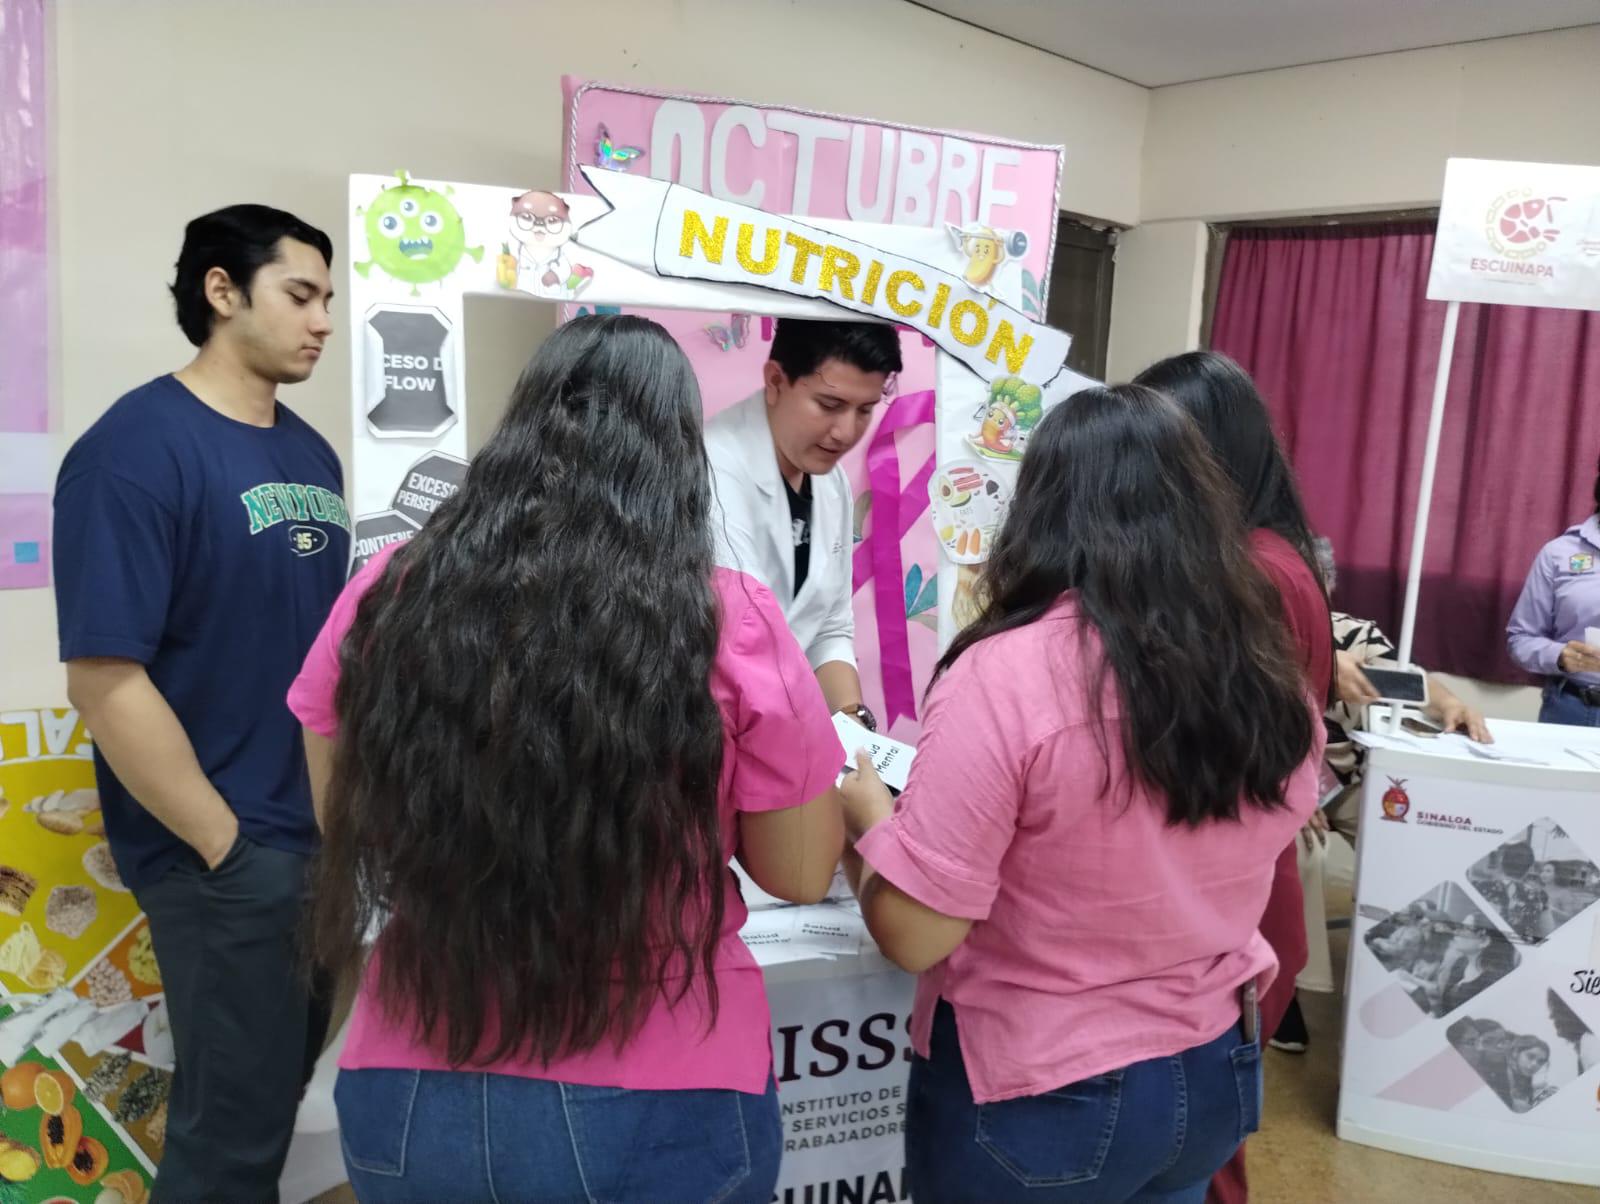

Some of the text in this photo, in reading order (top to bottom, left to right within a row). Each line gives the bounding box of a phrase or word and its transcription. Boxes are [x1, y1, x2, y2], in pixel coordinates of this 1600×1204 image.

[649, 99, 1022, 228] OCTUBRE
[1470, 258, 1554, 278] ESCUINAPA
[679, 209, 1035, 375] NUTRICIÓN
[876, 745, 901, 774] Mental
[1416, 811, 1473, 826] SINALOA
[777, 1012, 913, 1083] ISS
[782, 1085, 901, 1116] NSTITUTO DE
[792, 1105, 890, 1133] SERVICIOS
